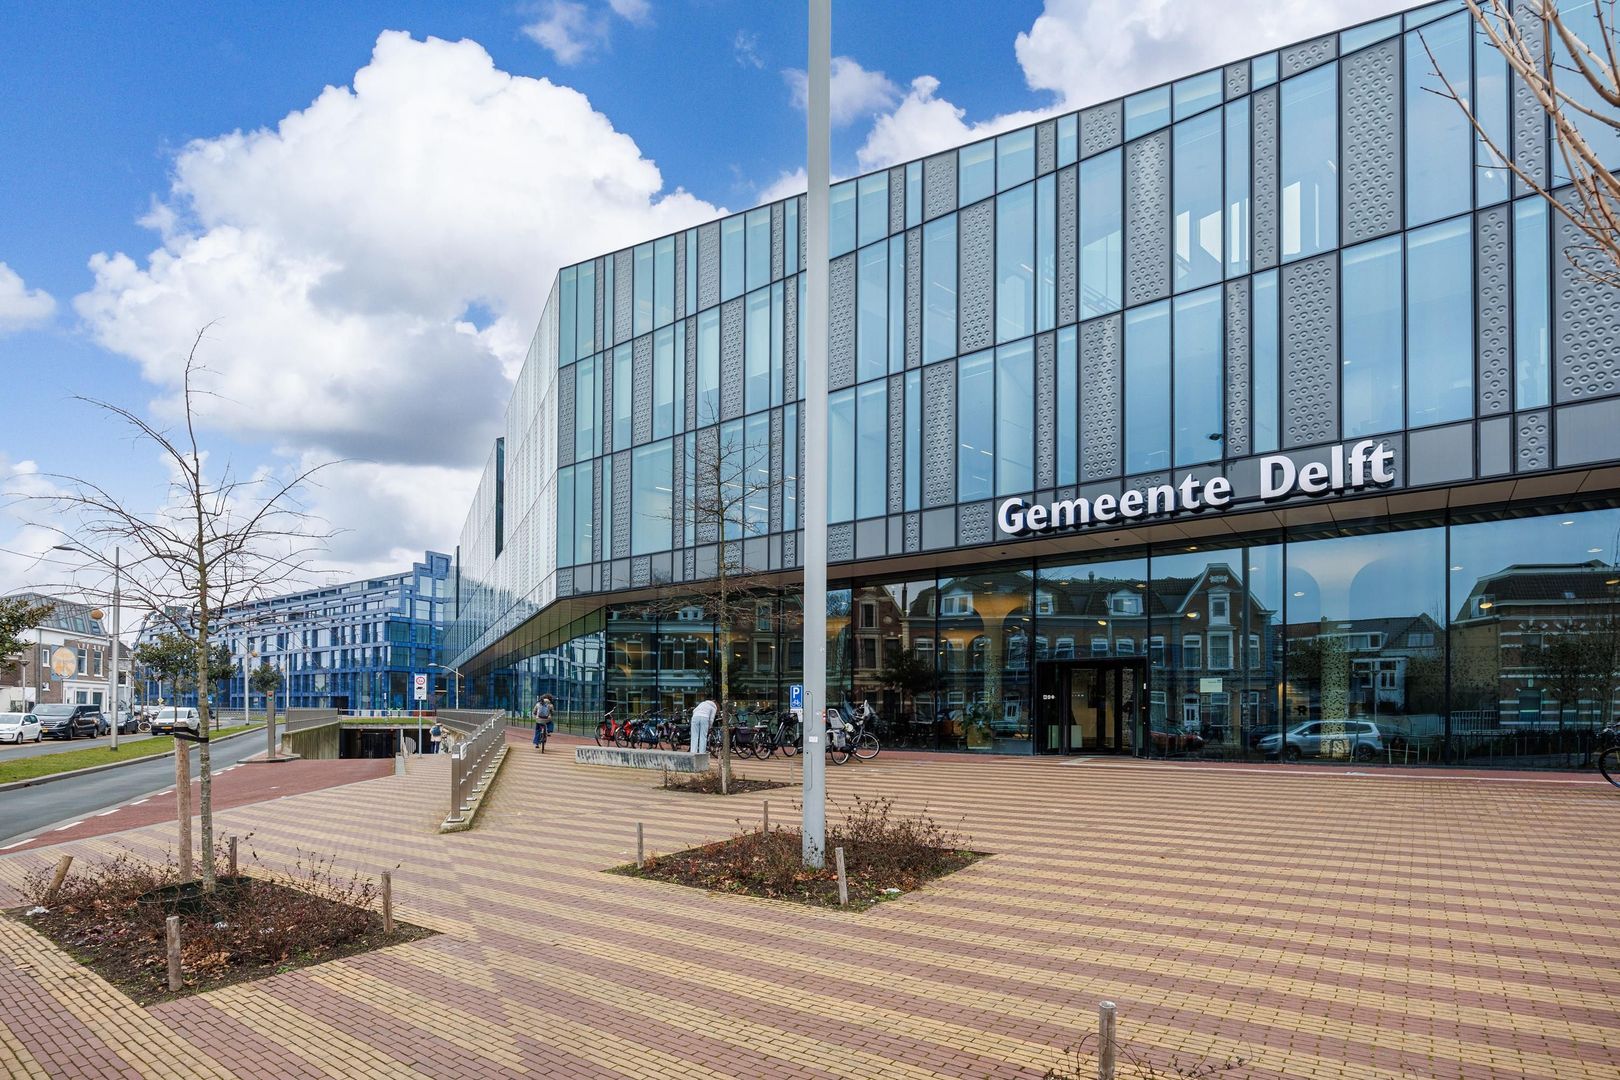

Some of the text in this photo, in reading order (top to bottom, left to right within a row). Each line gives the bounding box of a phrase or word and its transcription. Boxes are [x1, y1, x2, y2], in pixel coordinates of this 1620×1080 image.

[997, 439, 1394, 534] Gemeente Delft
[793, 687, 800, 699] P
